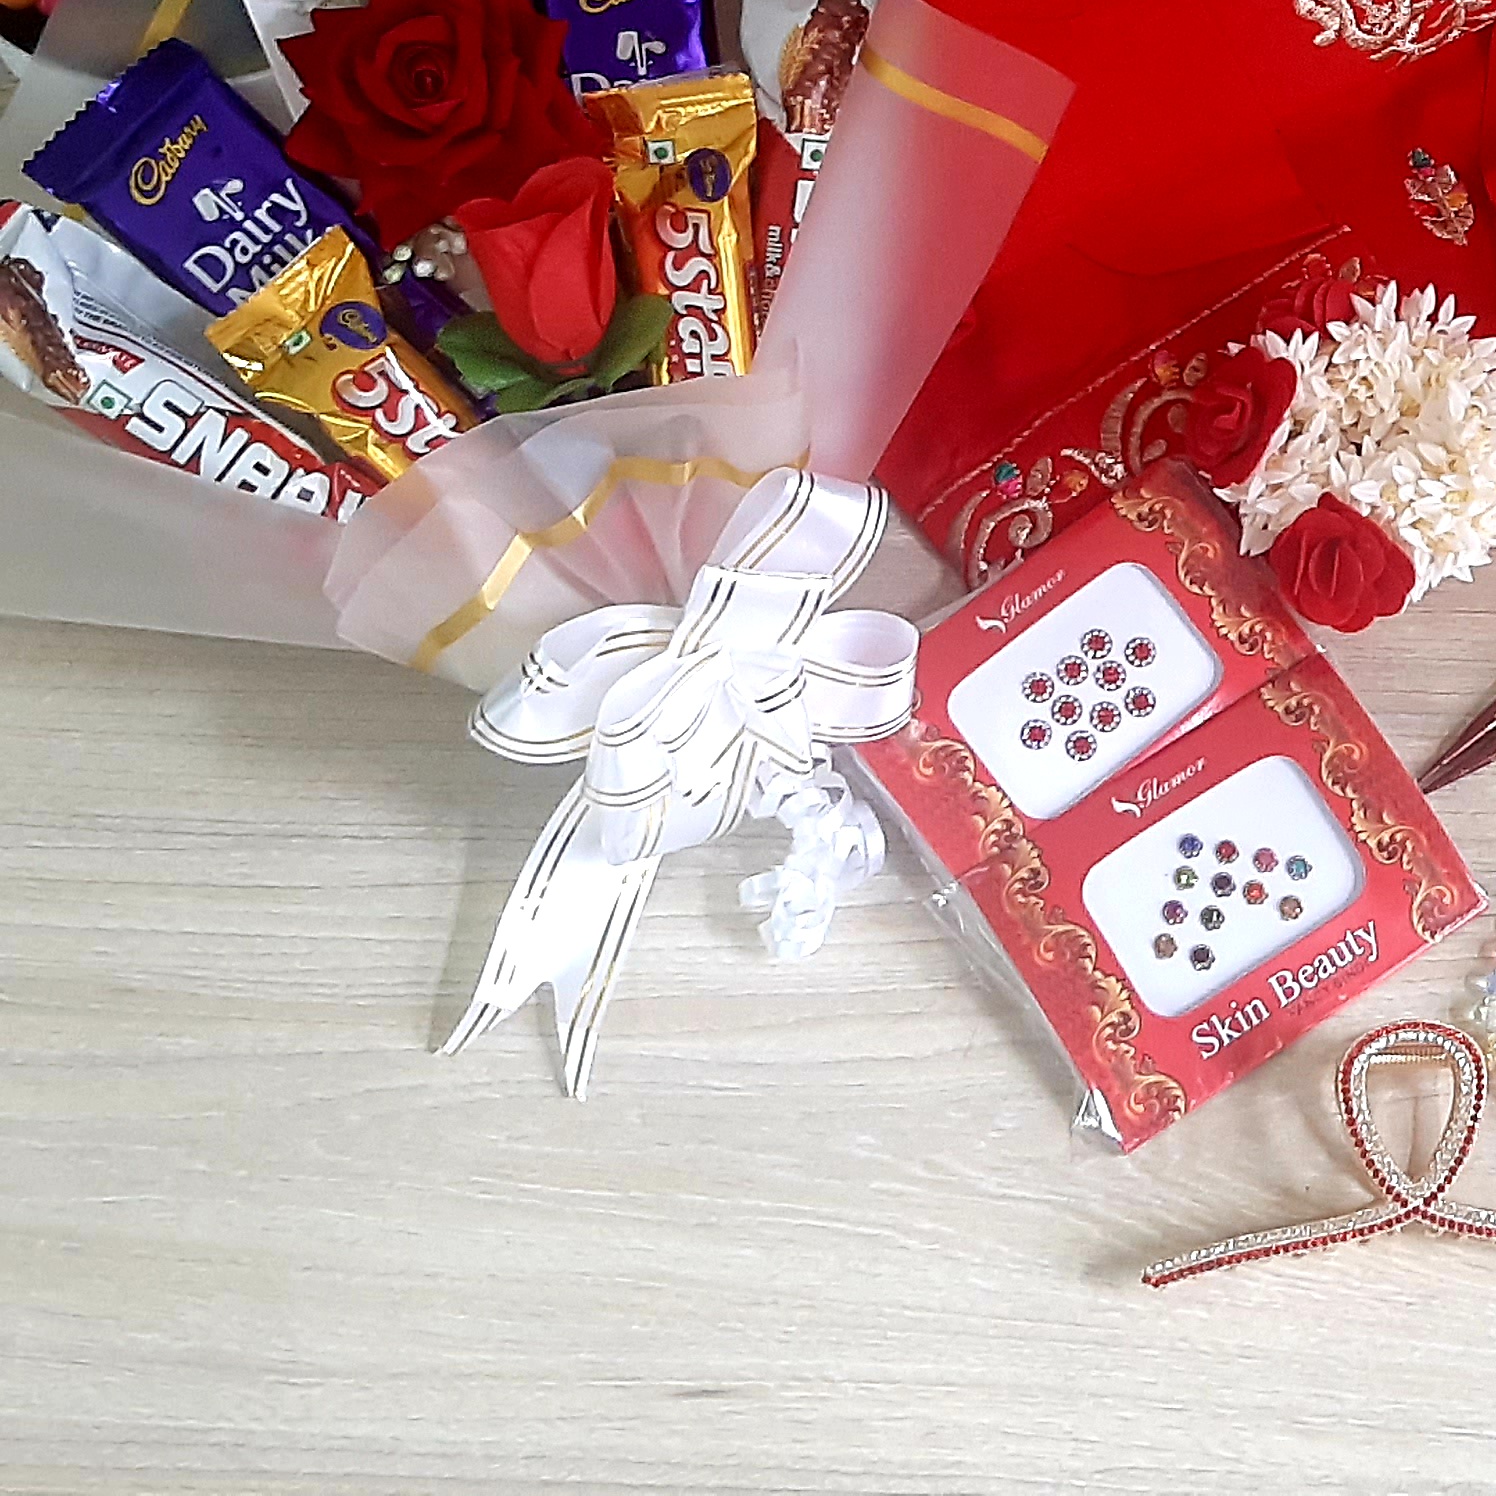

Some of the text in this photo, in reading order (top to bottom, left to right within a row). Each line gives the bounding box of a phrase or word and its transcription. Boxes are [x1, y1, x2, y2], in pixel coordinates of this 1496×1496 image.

[129, 114, 209, 205] Cadbury
[182, 177, 308, 294] Dairy
[1190, 919, 1380, 1061] Skin Beauty
